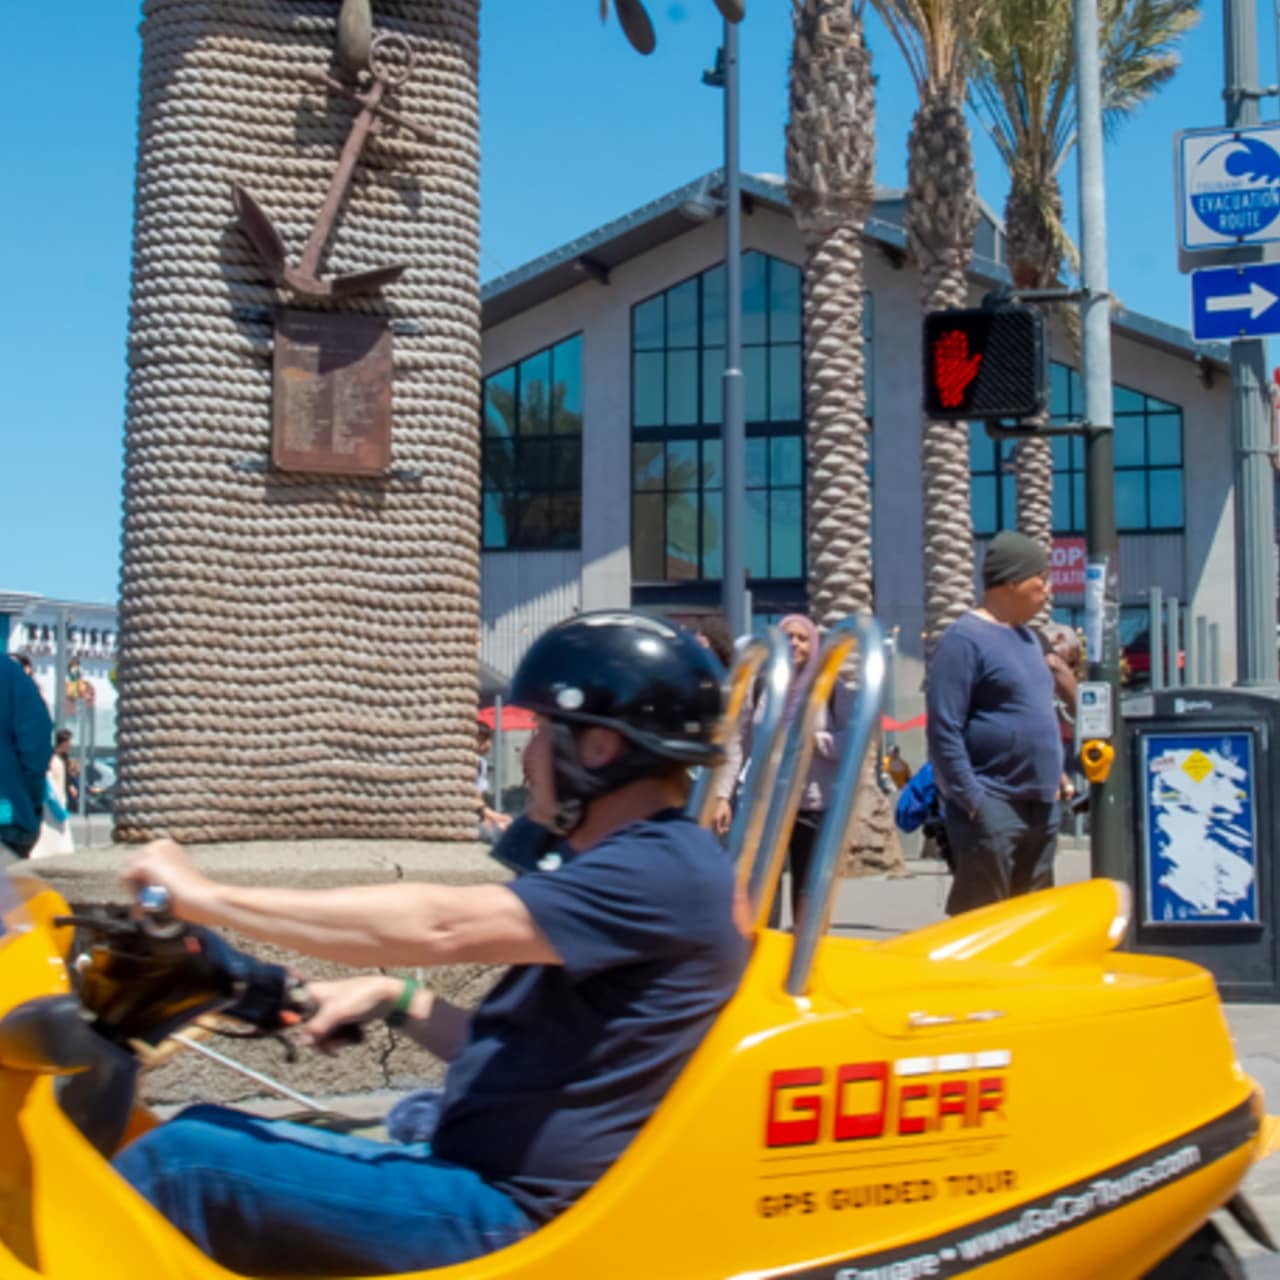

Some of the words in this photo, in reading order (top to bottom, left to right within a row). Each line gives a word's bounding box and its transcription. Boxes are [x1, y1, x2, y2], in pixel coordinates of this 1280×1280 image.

[1198, 190, 1280, 213] EVACUATION
[1219, 210, 1261, 230] ROUTE
[757, 1190, 818, 1219] GPS
[826, 1177, 938, 1211] GUIDED
[945, 1169, 1018, 1199] TOUR
[955, 1144, 1201, 1261] www.GoCarTours.com
